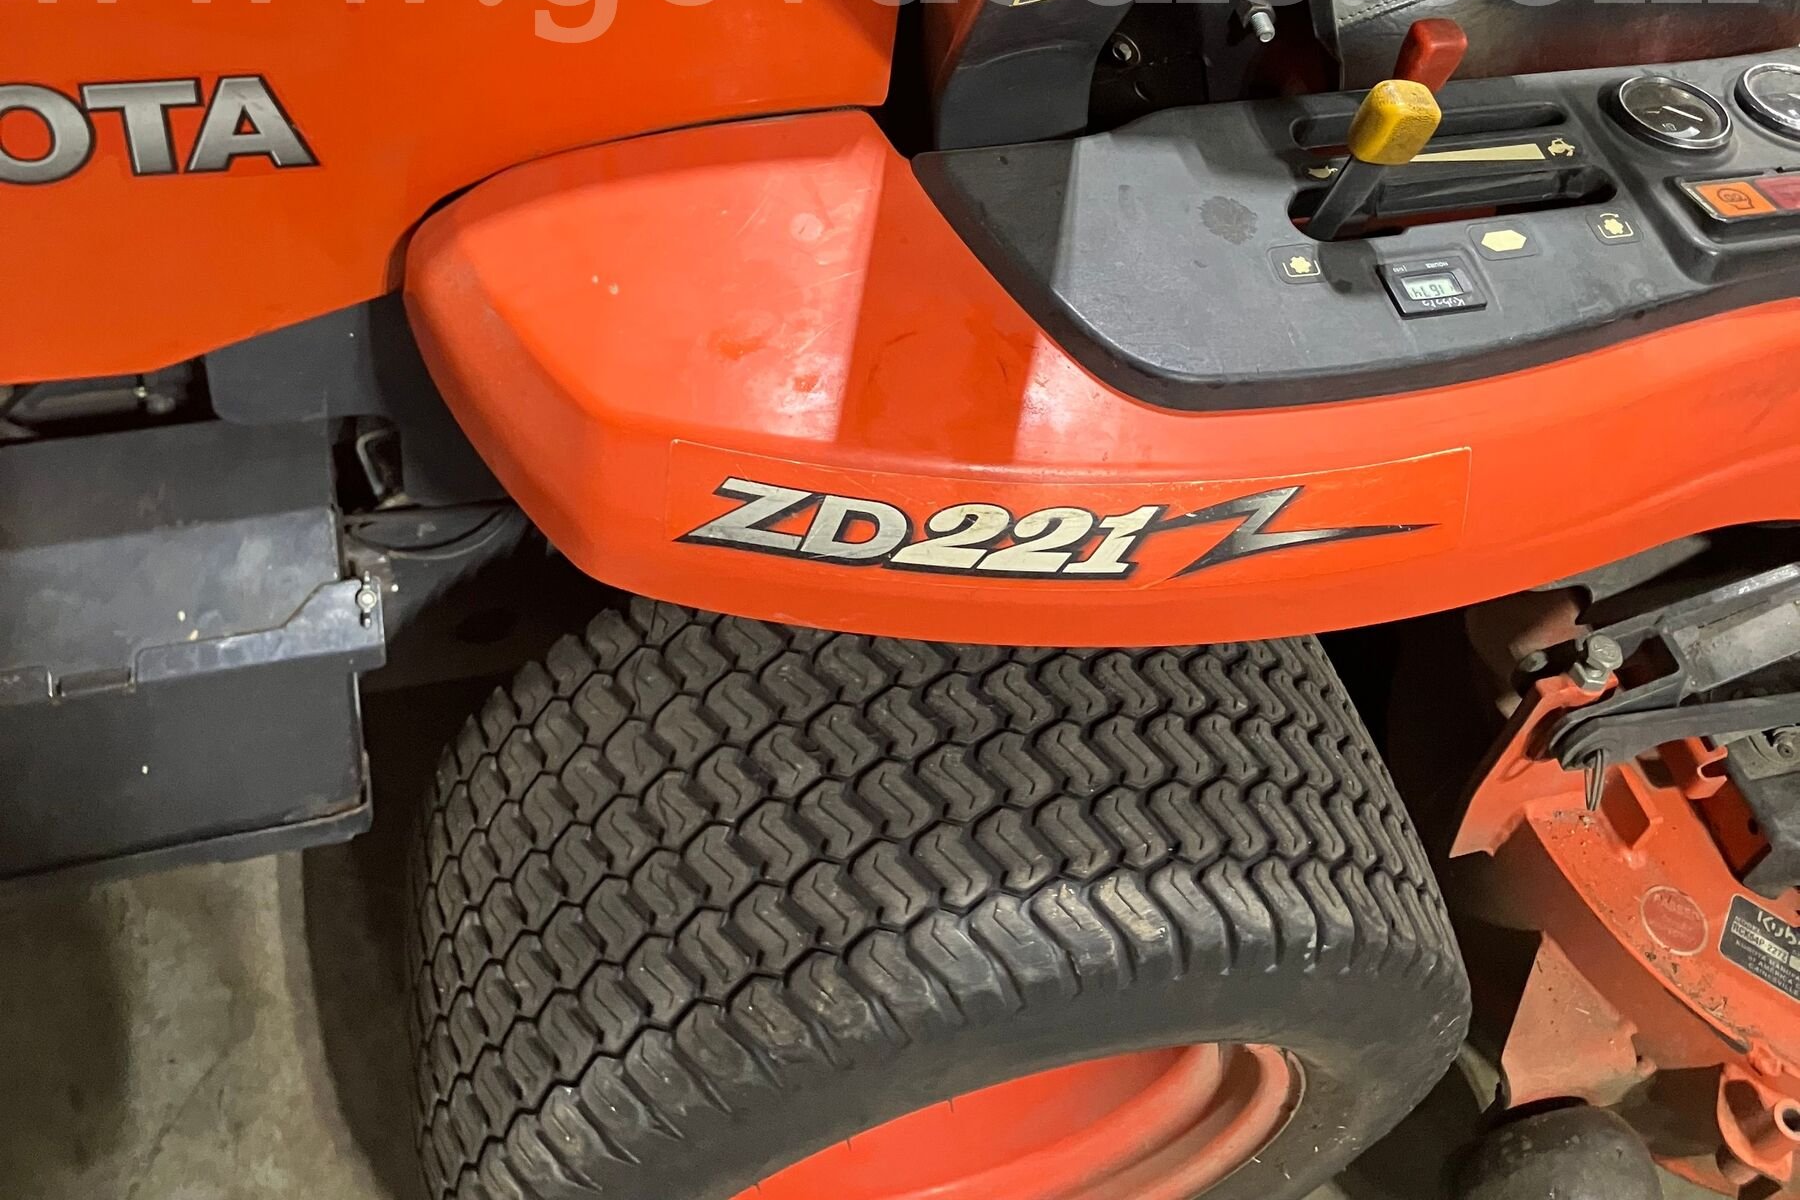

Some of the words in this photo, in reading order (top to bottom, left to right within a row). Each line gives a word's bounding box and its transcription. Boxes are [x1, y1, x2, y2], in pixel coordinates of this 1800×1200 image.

[1422, 296, 1466, 308] Kubota
[672, 475, 1168, 580] ZD221
[1758, 910, 1800, 946] Kub
